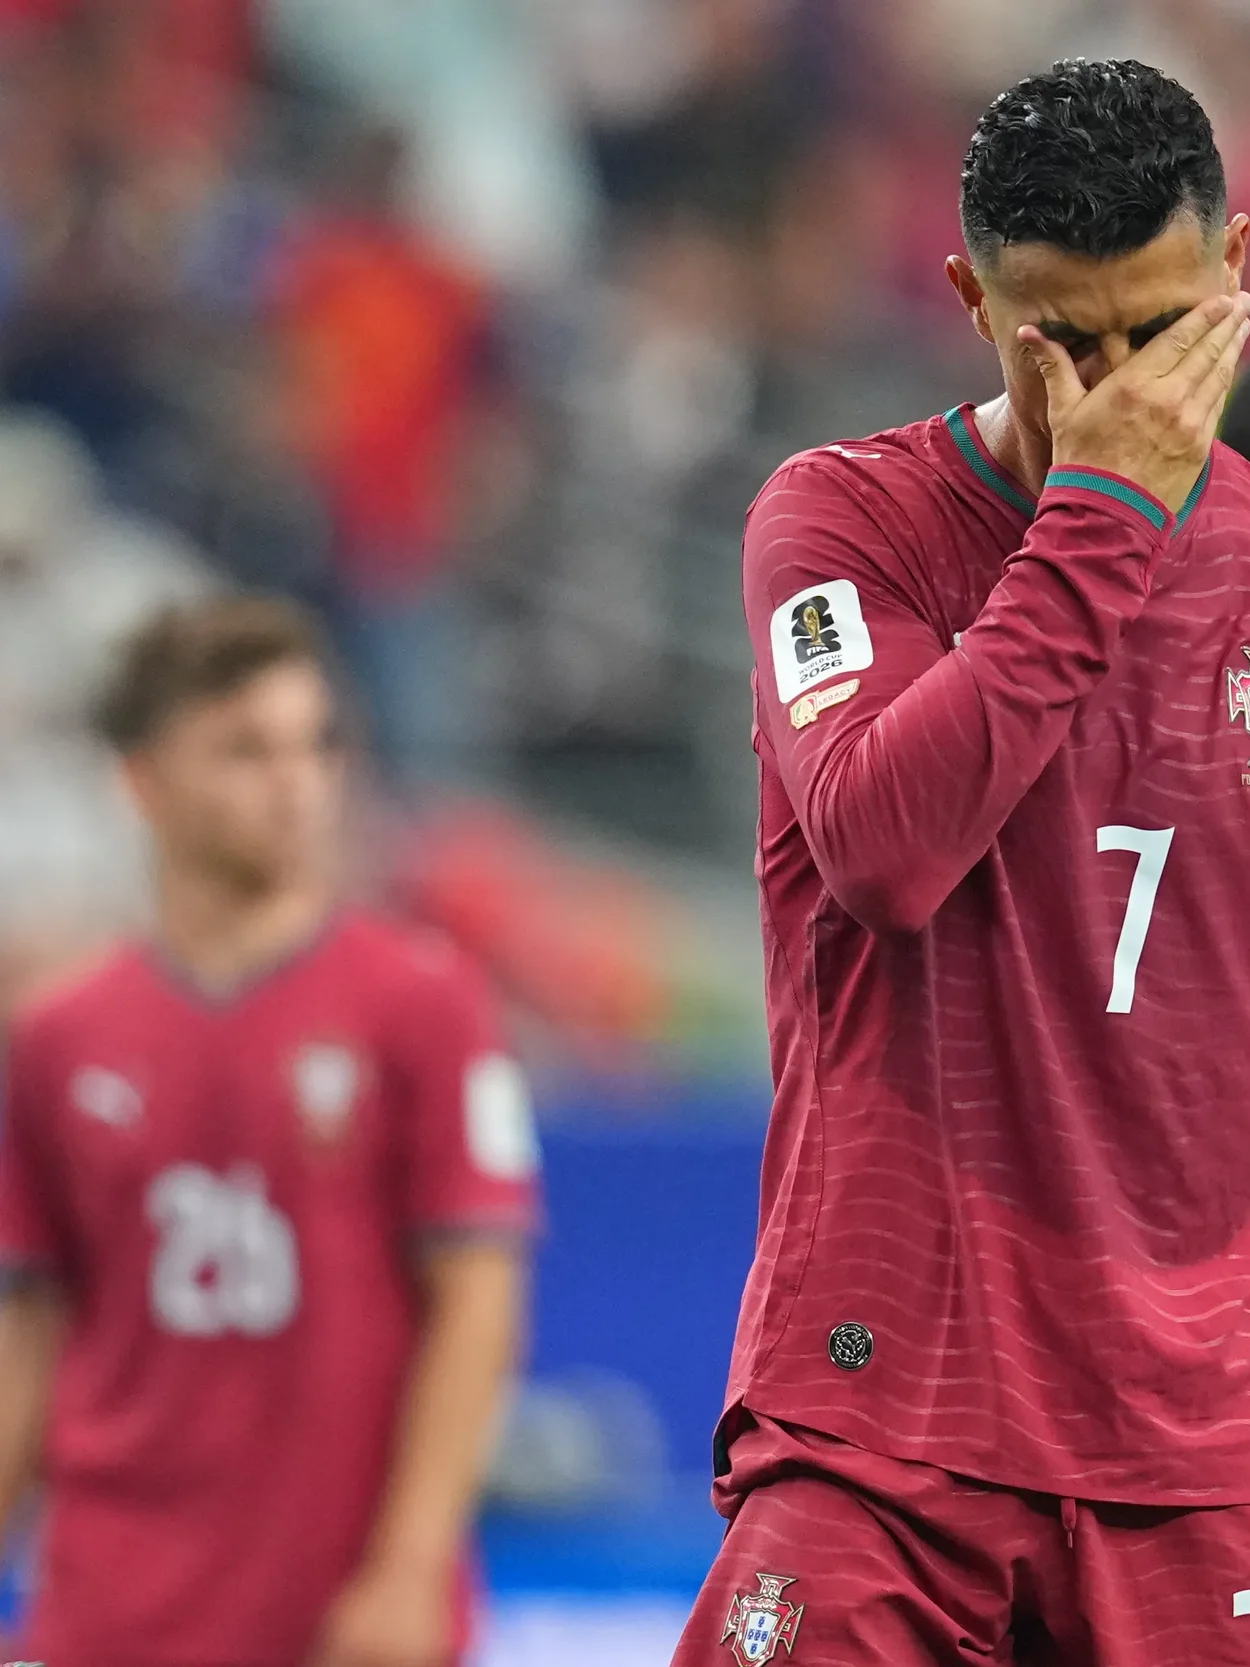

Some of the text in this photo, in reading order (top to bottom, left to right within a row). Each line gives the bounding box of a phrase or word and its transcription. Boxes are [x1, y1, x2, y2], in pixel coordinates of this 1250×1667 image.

[799, 657, 824, 675] WORLD
[800, 659, 843, 684] 2026
[818, 688, 851, 704] LEGACY
[1096, 825, 1176, 1014] 7
